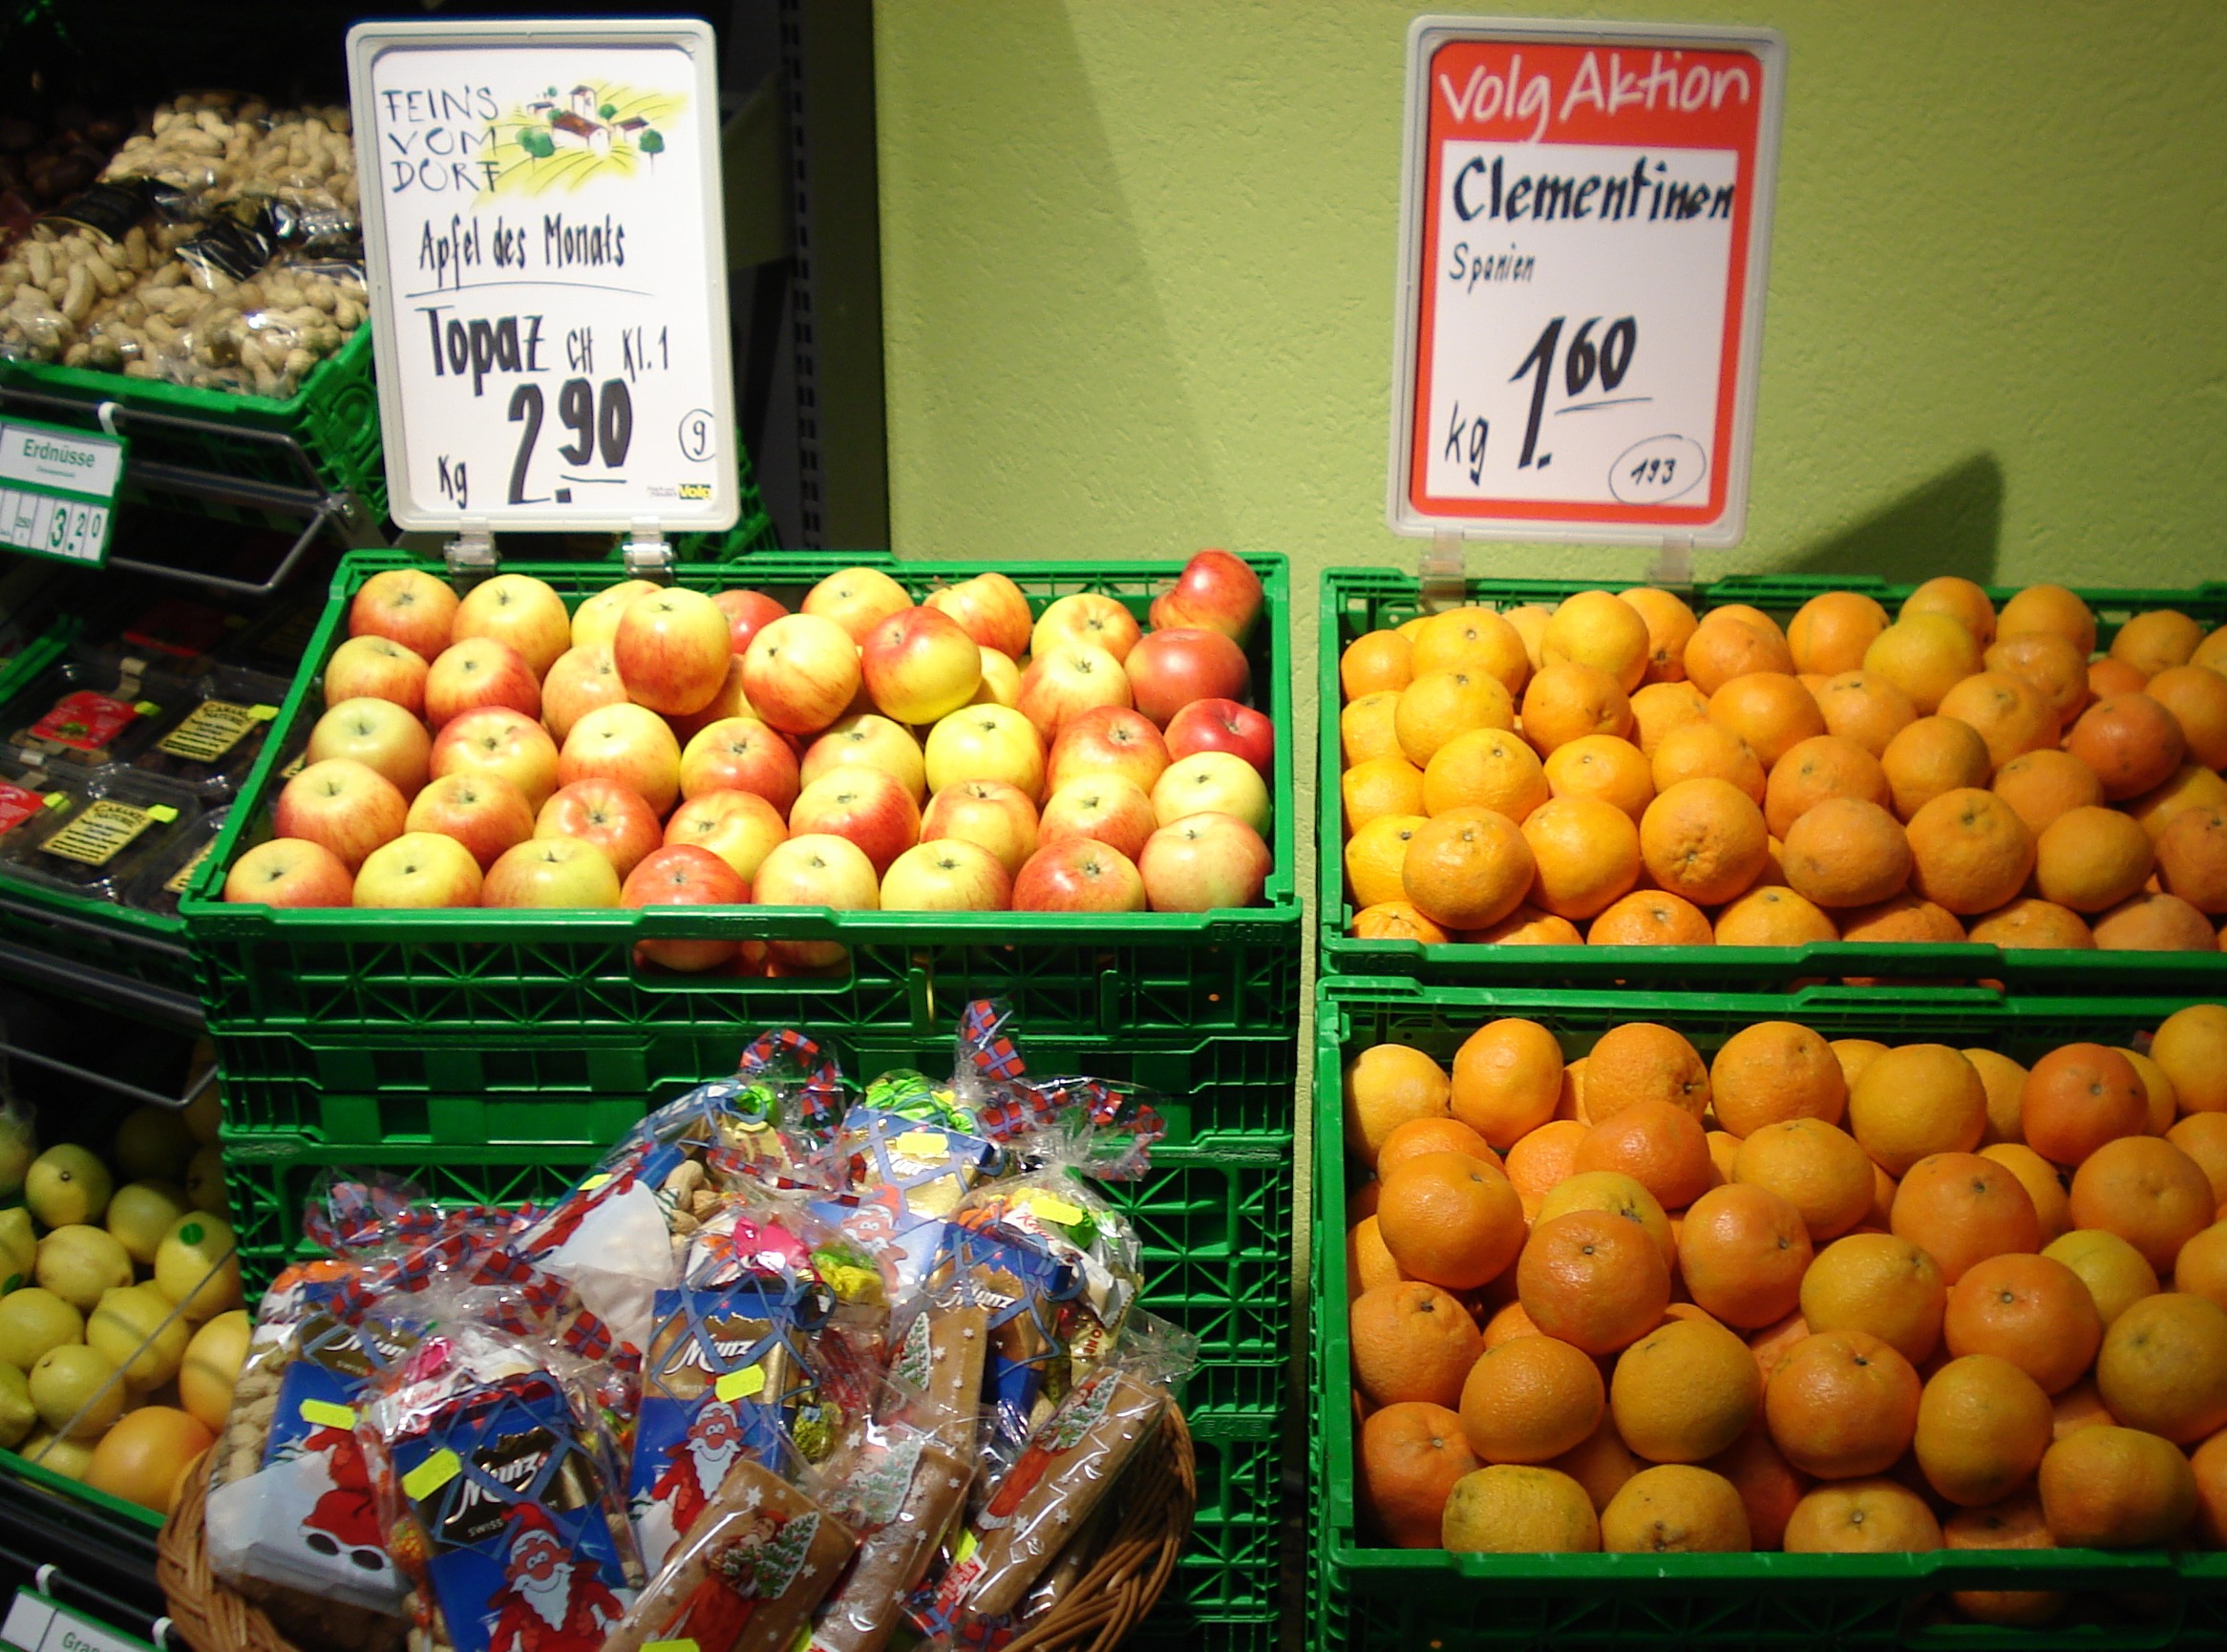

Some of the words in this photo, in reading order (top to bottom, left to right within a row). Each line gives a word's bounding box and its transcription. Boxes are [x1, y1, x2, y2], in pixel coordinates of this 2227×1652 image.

[1559, 51, 1750, 122] Aktion
[388, 125, 497, 156] VOM
[390, 158, 500, 193] DORF
[1453, 155, 1735, 222] Clementinen
[419, 213, 481, 290] Apfel
[493, 215, 525, 269] des
[543, 212, 625, 269] Monats
[1449, 242, 1536, 294] Spanien
[414, 306, 550, 396] Topaz
[567, 326, 593, 374] CH
[23, 438, 95, 468] Erdnüsse
[693, 420, 706, 455] 9
[1631, 458, 1677, 486] 193
[679, 484, 711, 500] Volg
[63, 1632, 102, 1652] Gra
